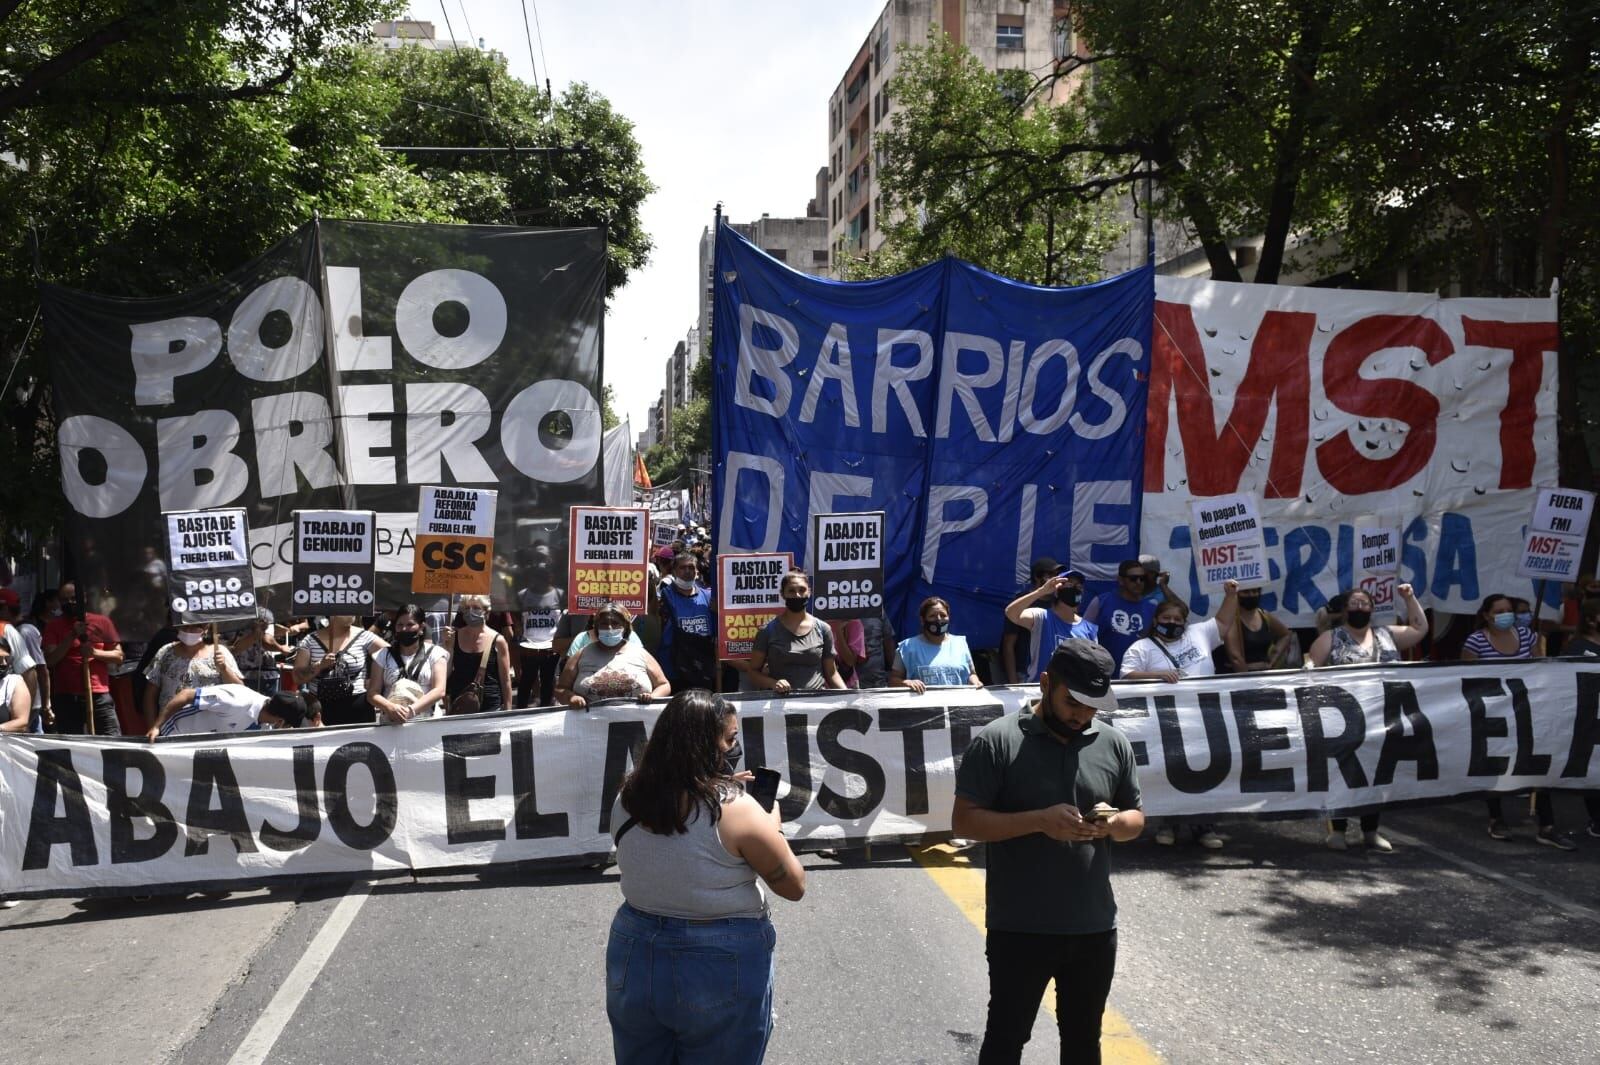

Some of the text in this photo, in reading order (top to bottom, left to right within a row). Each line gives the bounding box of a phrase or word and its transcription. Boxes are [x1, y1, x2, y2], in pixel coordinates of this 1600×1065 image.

[130, 266, 508, 406] POLO
[735, 302, 1143, 443] BARRIOS
[1143, 300, 1560, 500] MST
[58, 378, 601, 519] OBRERO
[434, 489, 478, 501] ABAJO LA
[1549, 494, 1583, 511] FUERA
[435, 499, 476, 511] REFORMA
[1201, 503, 1246, 523] No pagar la
[434, 509, 472, 521] LABORAL
[584, 516, 637, 530] BASTA DE
[178, 516, 236, 533] BASTA DE
[303, 521, 365, 535] TRABAJO
[429, 522, 476, 534] FUERA EL FMI
[824, 522, 878, 540] ABAJO EL
[920, 480, 1132, 585] PIE
[1199, 518, 1257, 540] deuda externa
[1550, 517, 1572, 532] FMI
[183, 531, 232, 548] AJUSTE
[303, 537, 362, 552] GENUINO
[588, 531, 632, 545] AJUSTE
[1361, 532, 1389, 549] Romper
[1527, 536, 1562, 555] MST
[181, 551, 235, 563] FUERA EL FMI
[422, 541, 487, 571] CSC
[584, 550, 633, 560] FUERA EL FMI
[824, 541, 876, 562] AJUSTE
[1202, 545, 1237, 566] MST
[1363, 547, 1396, 569] con el FMI
[732, 560, 783, 575] BASTA DE
[1525, 556, 1572, 572] TERESA VIVE
[575, 569, 644, 582] PARTIDO
[1207, 563, 1260, 582] TERESA VIVE
[185, 578, 241, 595] POLO
[308, 574, 362, 588] POLO
[577, 582, 641, 595] OBRERO
[735, 576, 778, 590] AJUSTE
[828, 579, 873, 595] POLO
[172, 592, 255, 612] OBRERO
[294, 590, 373, 604] OBRERO
[732, 593, 779, 604] FUERA EL FMI
[814, 594, 882, 610] OBRERO
[22, 741, 399, 872] ABAJO
[442, 728, 569, 845] EL
[1461, 677, 1552, 777] EL
